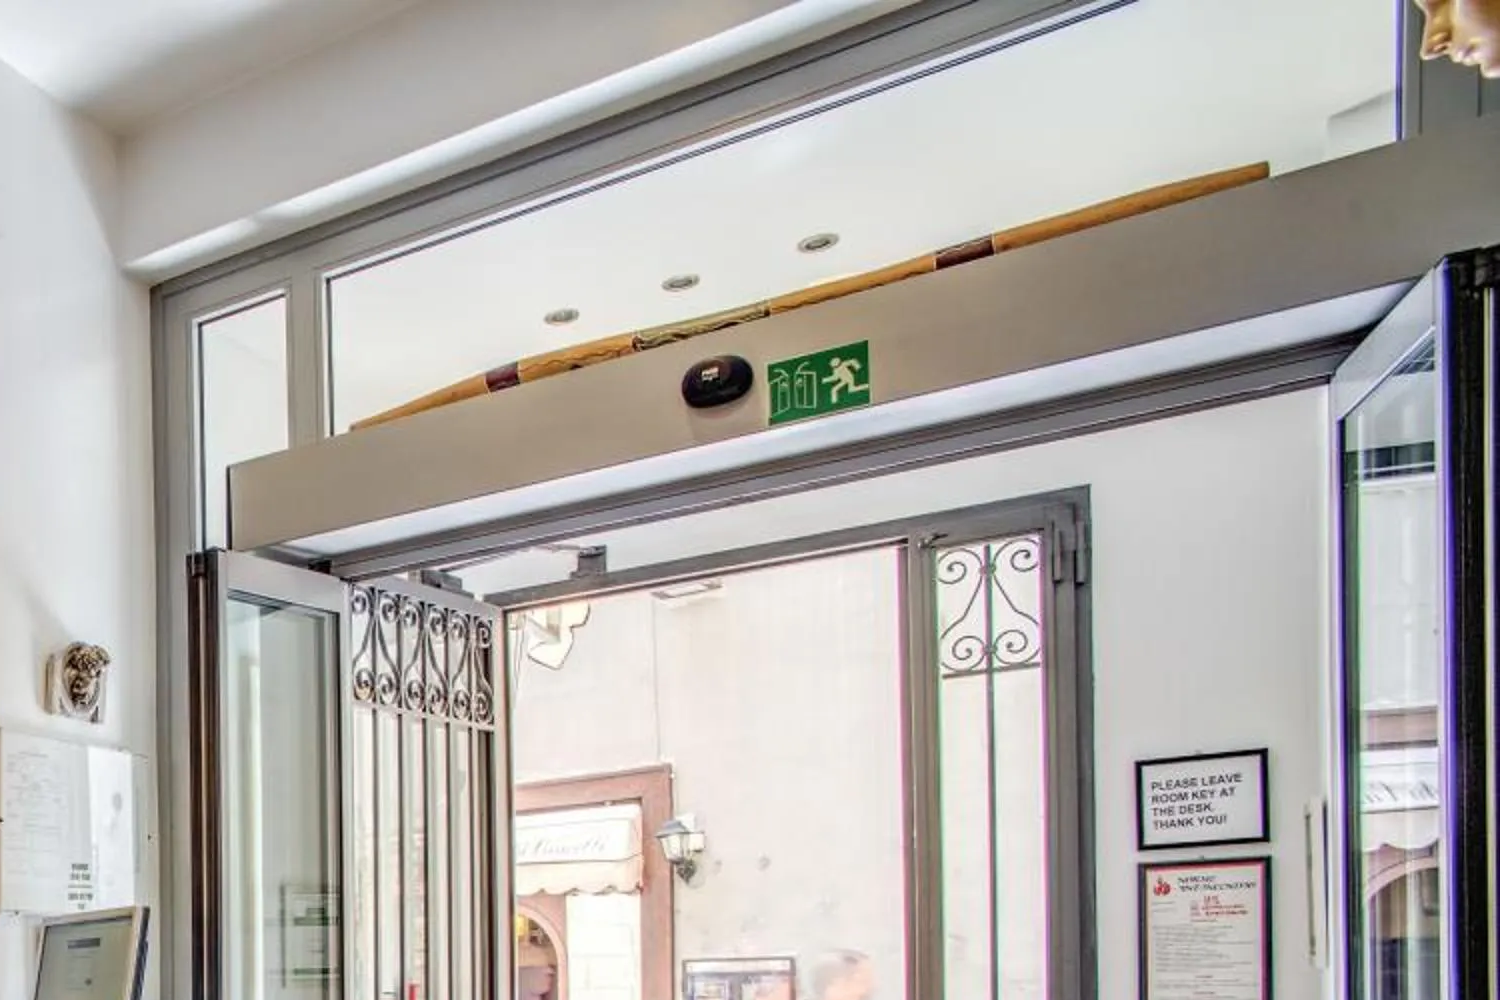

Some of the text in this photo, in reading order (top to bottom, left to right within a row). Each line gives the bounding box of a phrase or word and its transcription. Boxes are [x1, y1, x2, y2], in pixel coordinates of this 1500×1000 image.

[1151, 773, 1243, 791] PLEASE LEAVE
[1151, 787, 1236, 804] ROOM KEY AT
[1152, 806, 1175, 817] THE
[1153, 814, 1228, 831] THANK YOU!
